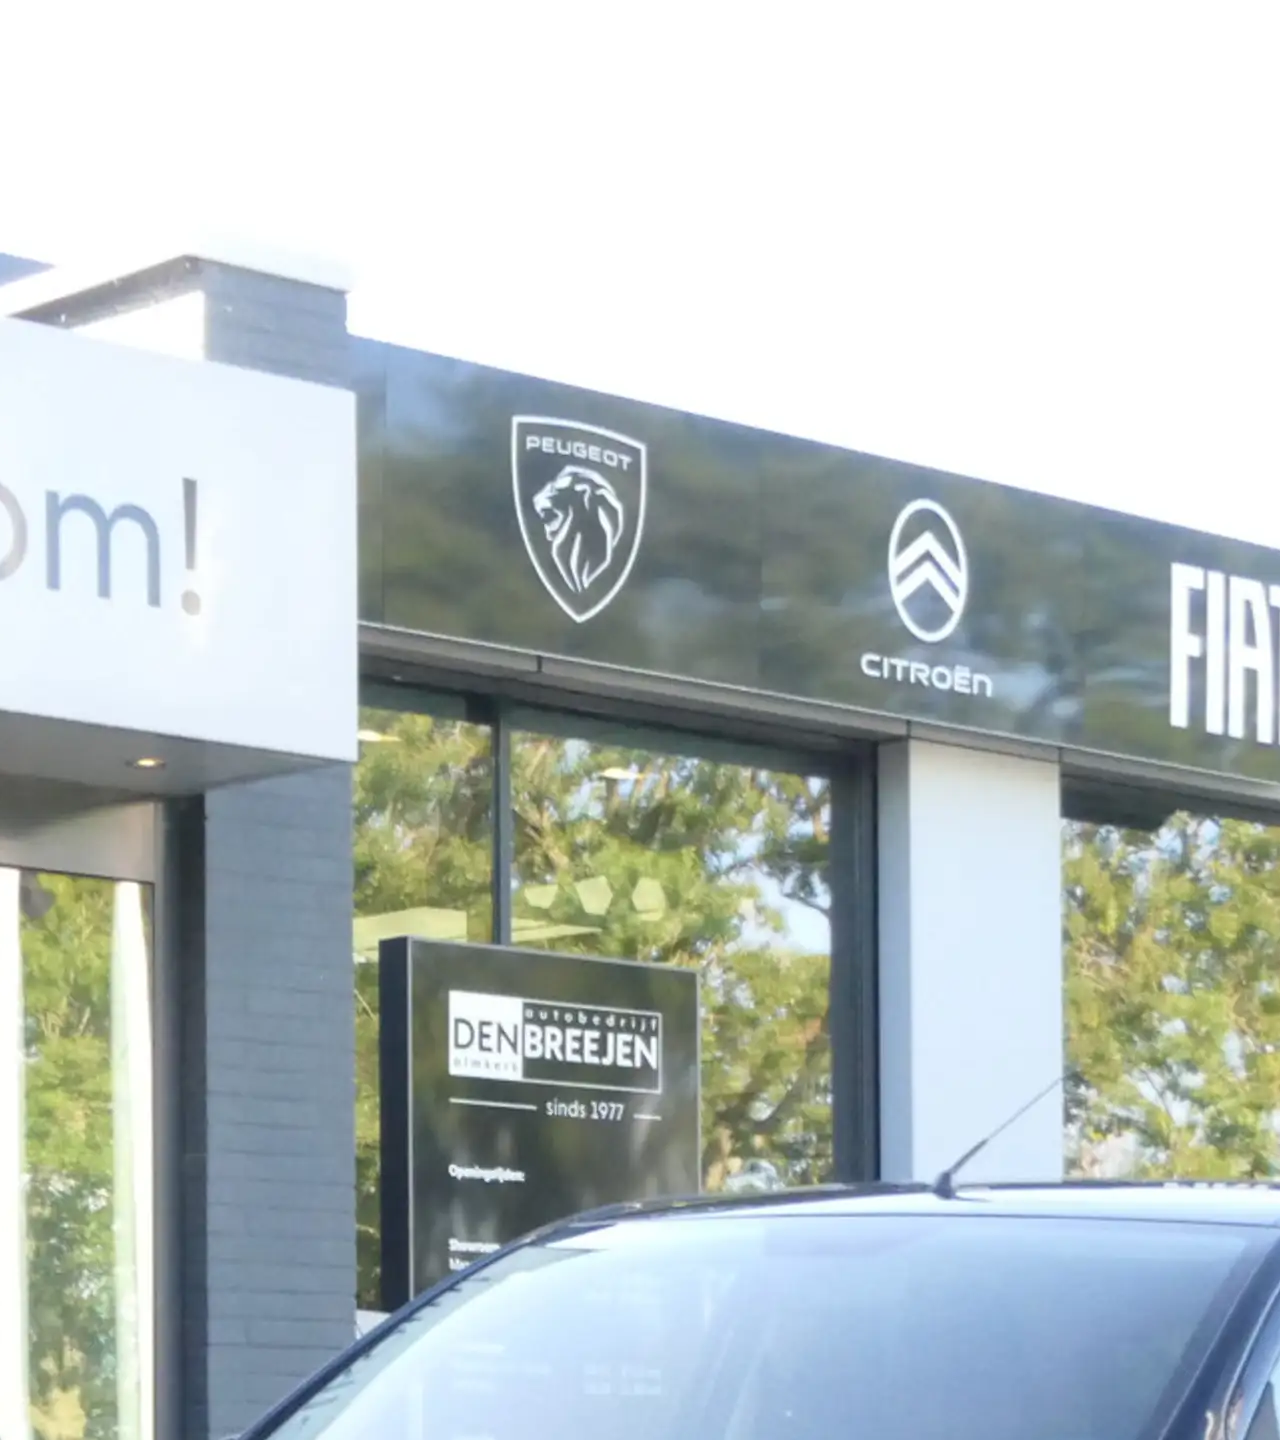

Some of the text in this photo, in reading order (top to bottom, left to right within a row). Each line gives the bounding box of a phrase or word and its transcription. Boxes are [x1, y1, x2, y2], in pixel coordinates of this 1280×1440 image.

[525, 434, 632, 471] PEUGEOT
[525, 1009, 658, 1033] autobedrijf
[454, 1018, 658, 1071] DEN BREEJEN
[546, 1098, 624, 1121] sinds 1977
